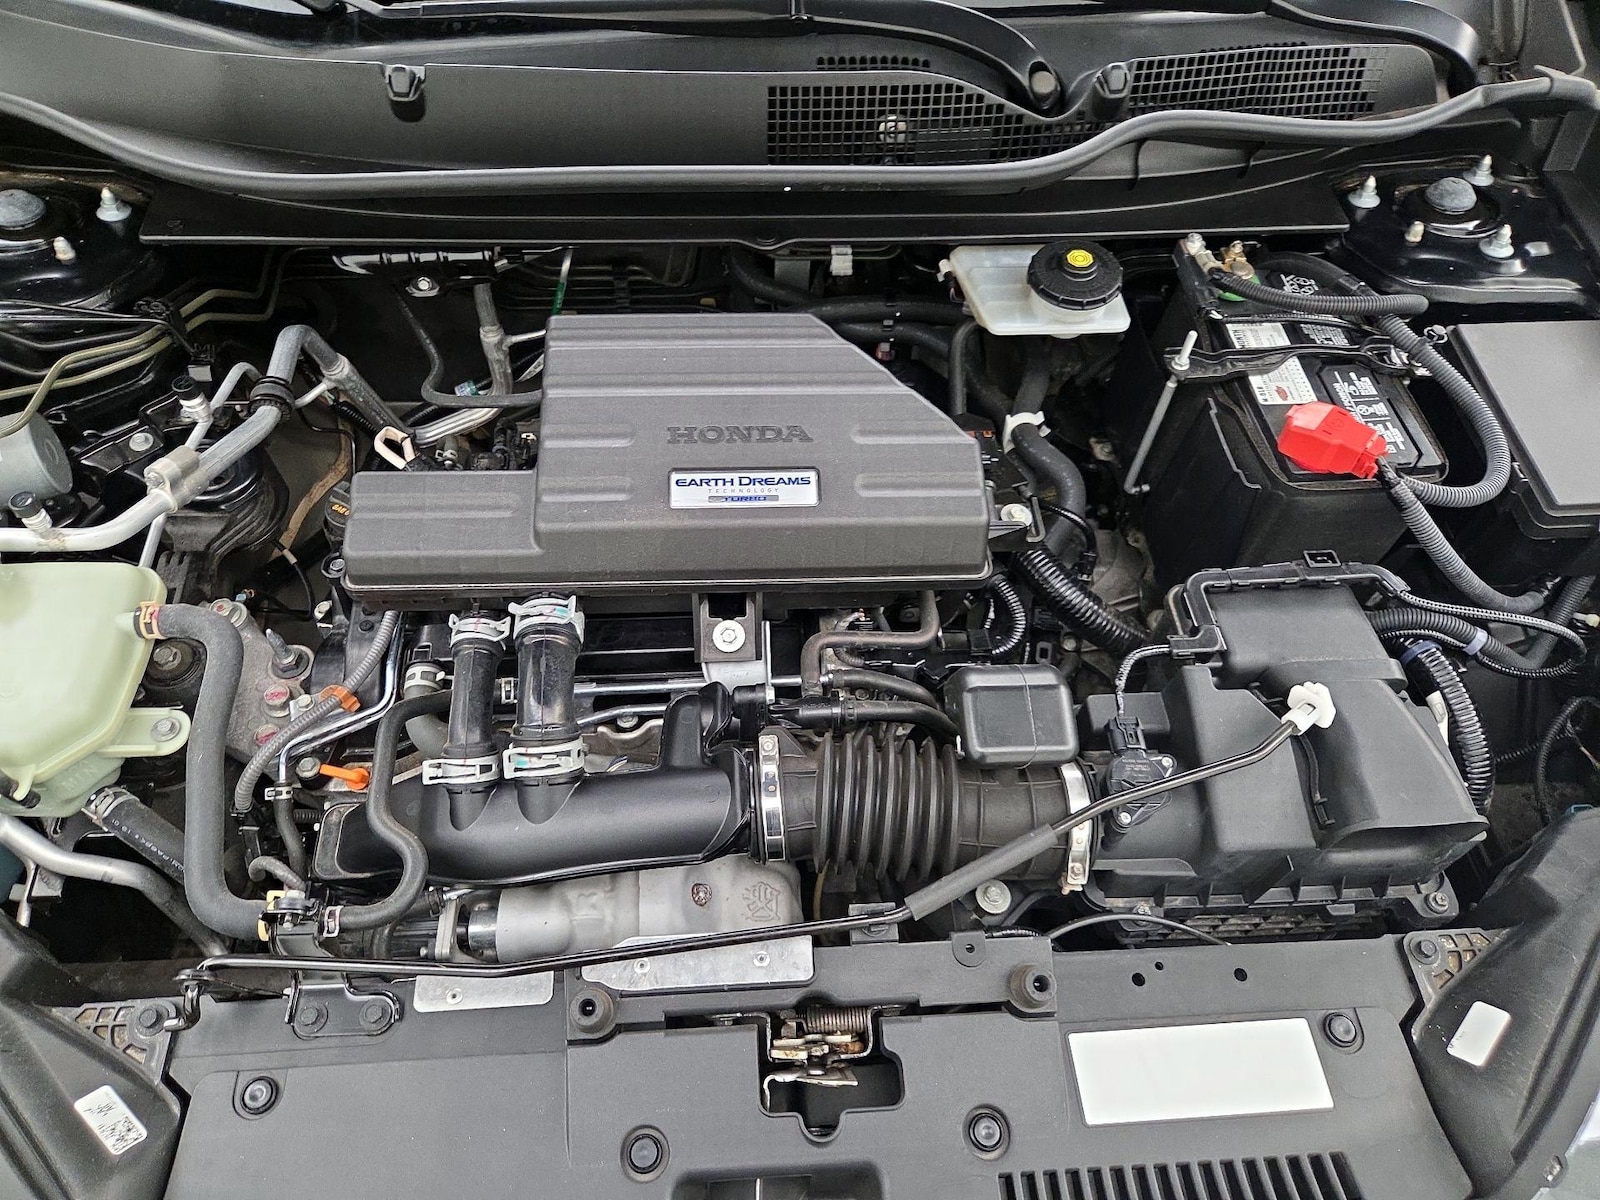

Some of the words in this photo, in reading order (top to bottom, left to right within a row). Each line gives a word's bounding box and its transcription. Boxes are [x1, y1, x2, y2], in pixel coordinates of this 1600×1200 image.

[667, 425, 813, 444] HONDA
[675, 478, 734, 487] EARTH
[738, 476, 811, 486] DREAMS
